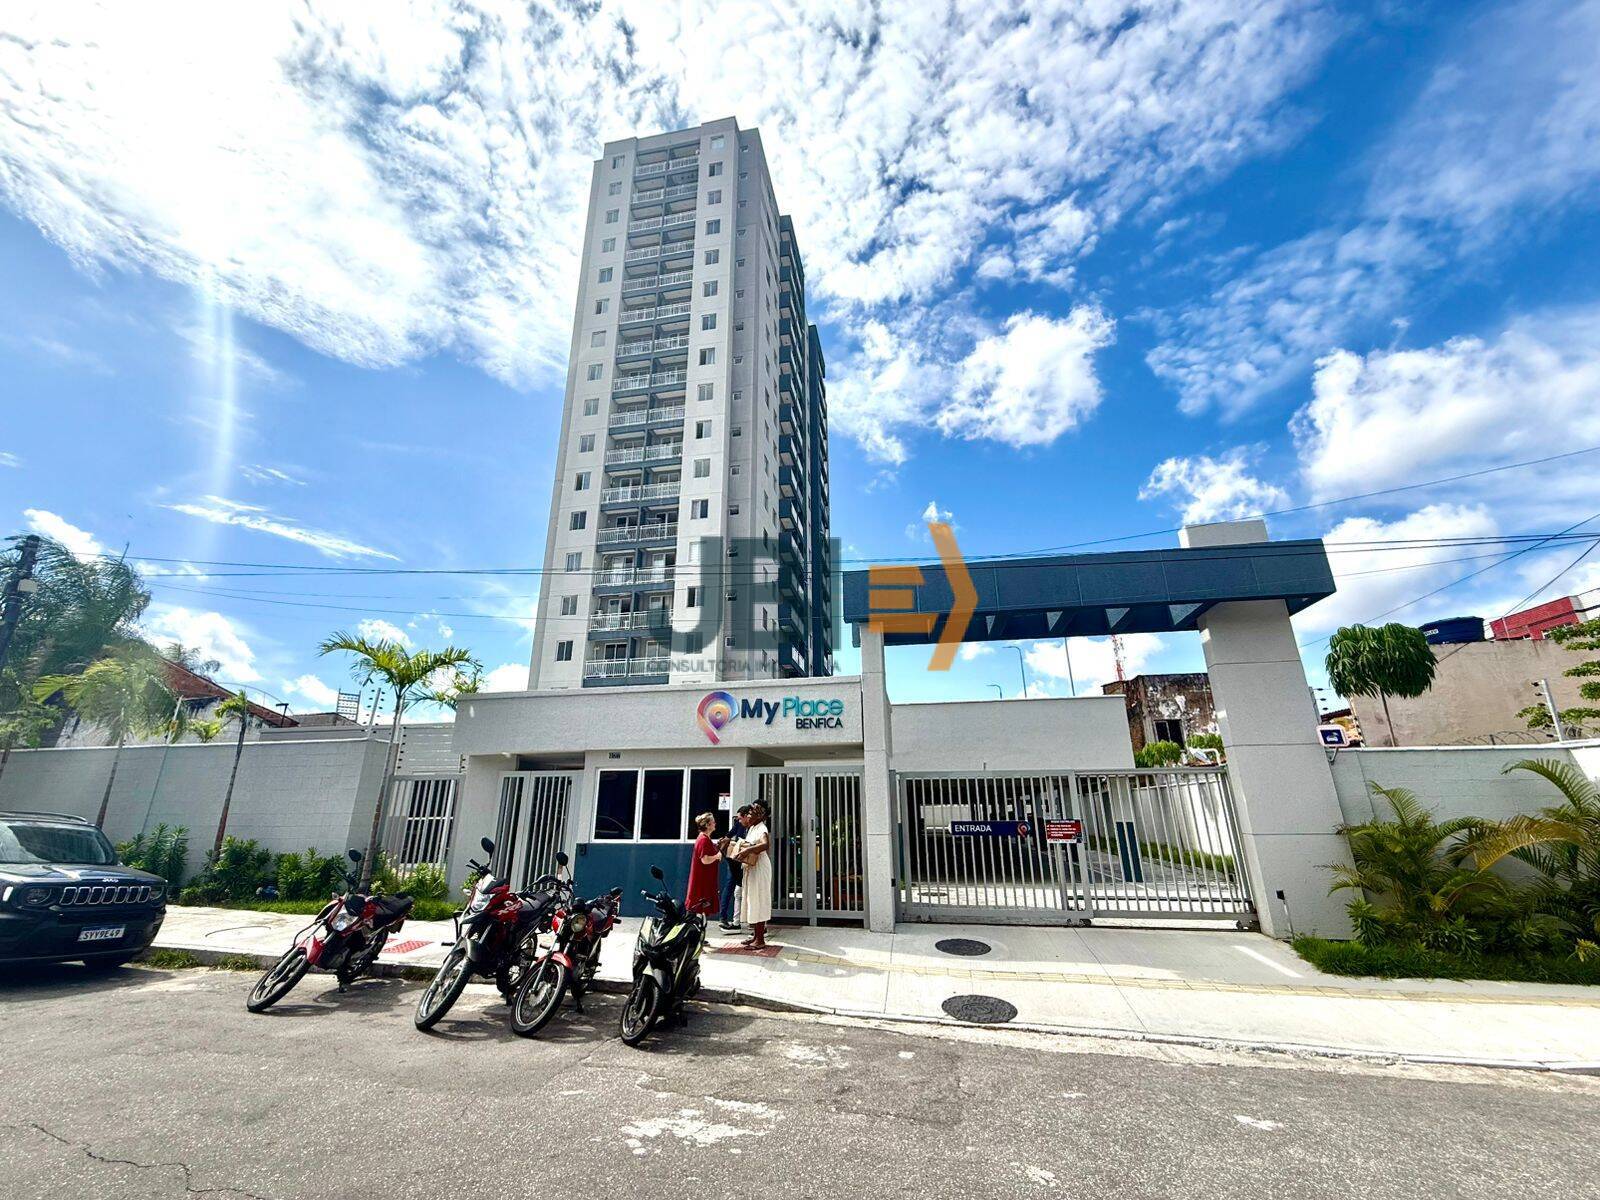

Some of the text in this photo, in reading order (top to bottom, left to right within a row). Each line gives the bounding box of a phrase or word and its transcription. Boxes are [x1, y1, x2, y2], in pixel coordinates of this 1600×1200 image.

[740, 696, 845, 725] My Place
[796, 717, 843, 729] BENFICA
[954, 824, 992, 832] ENTRADA
